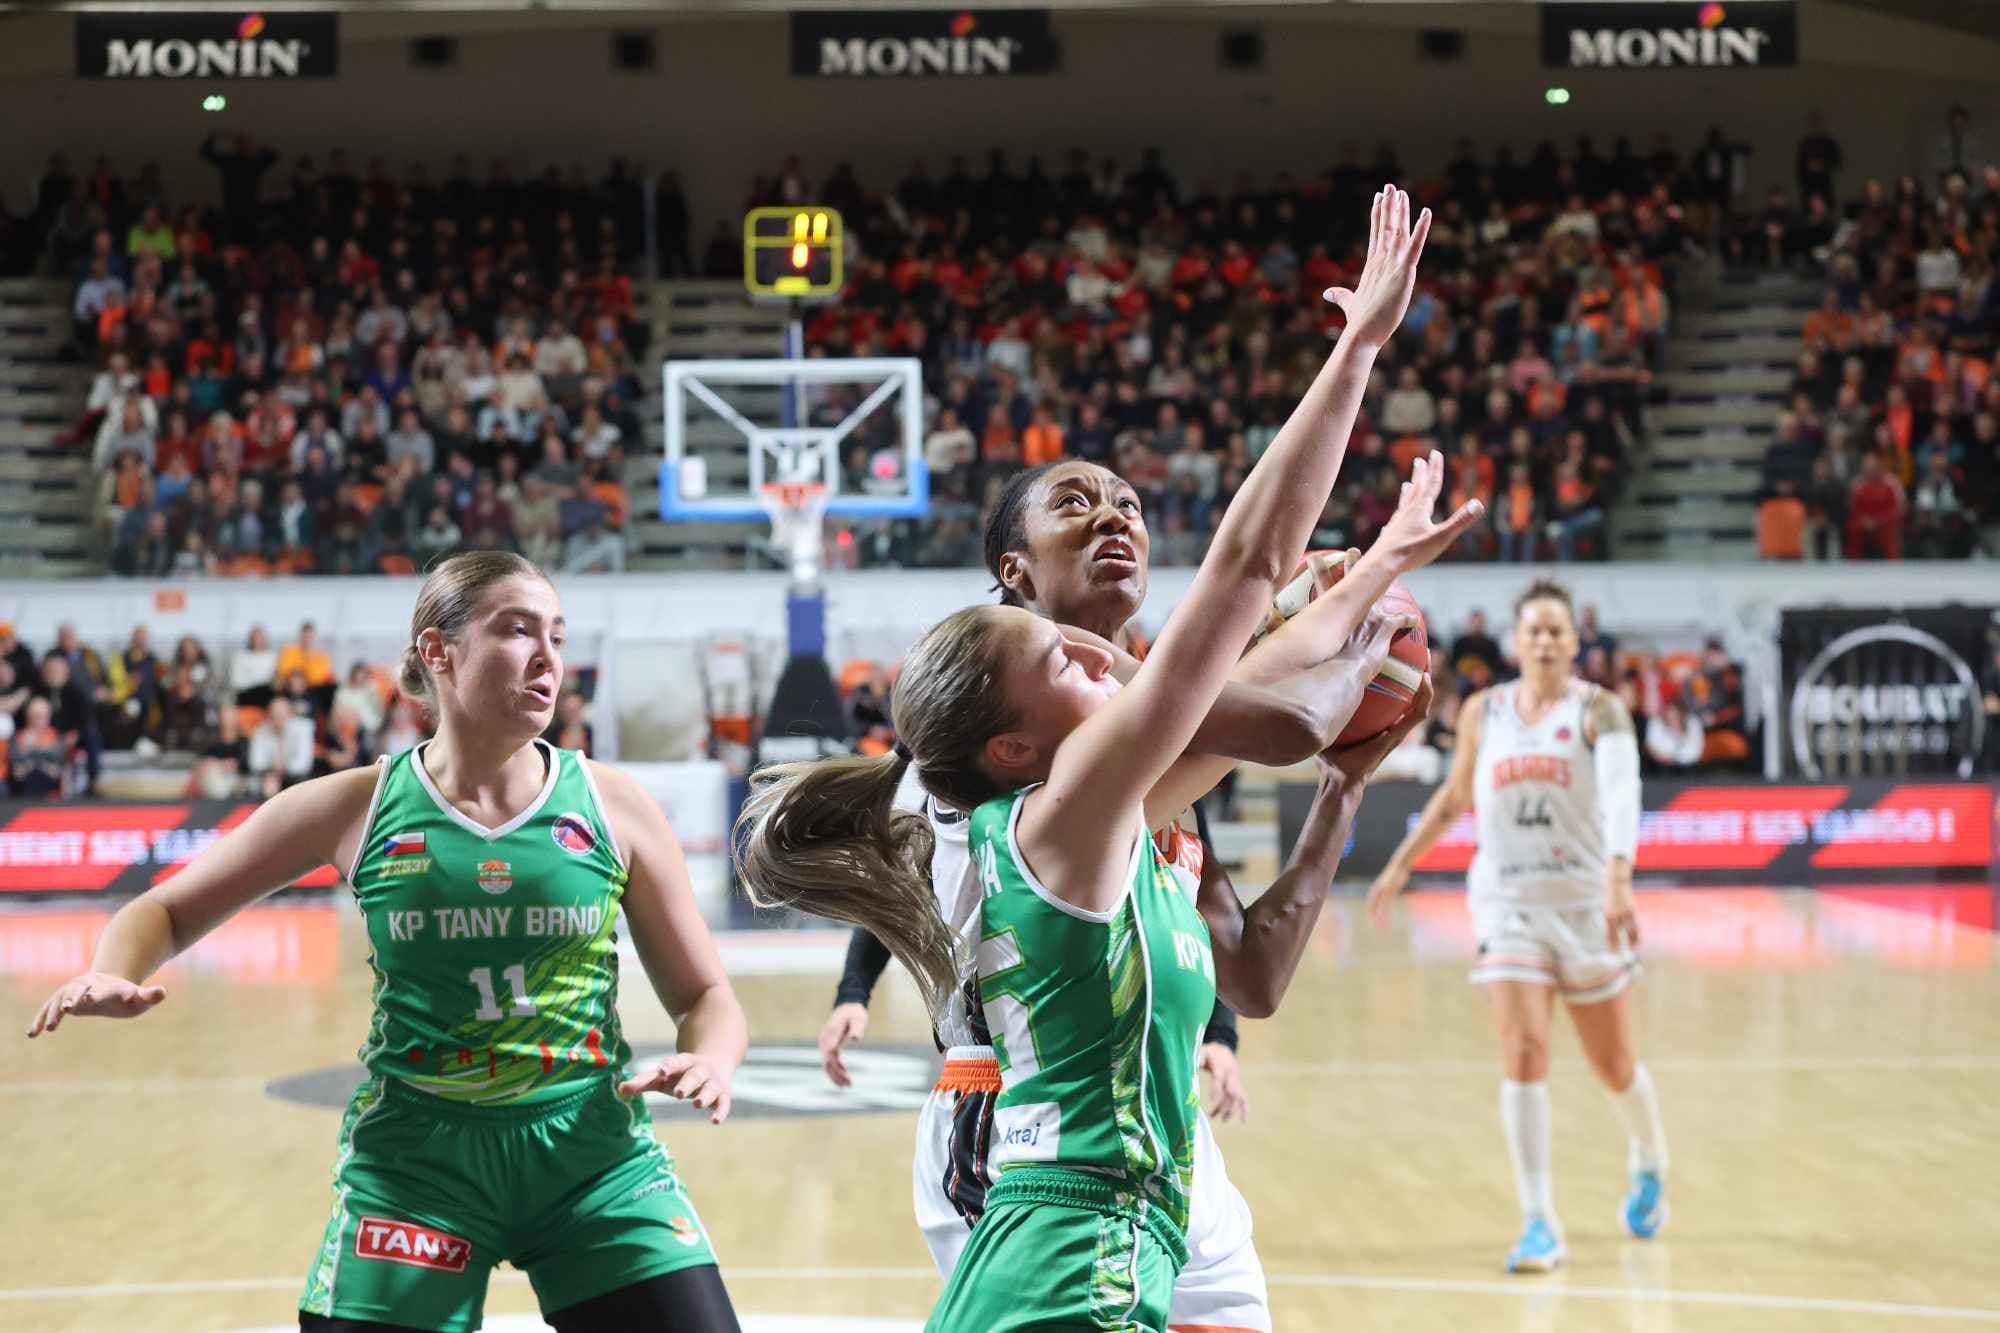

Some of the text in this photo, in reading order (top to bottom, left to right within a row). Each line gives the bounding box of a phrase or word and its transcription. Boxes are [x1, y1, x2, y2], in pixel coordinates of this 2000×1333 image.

[104, 37, 302, 78] MONIN
[818, 35, 1013, 76] MONIN
[1568, 26, 1761, 68] MONIN
[388, 905, 601, 942] KP TANY BRNO
[468, 963, 537, 1022] 11
[1003, 1122, 1041, 1147] kraj
[366, 1224, 462, 1263] TANY
